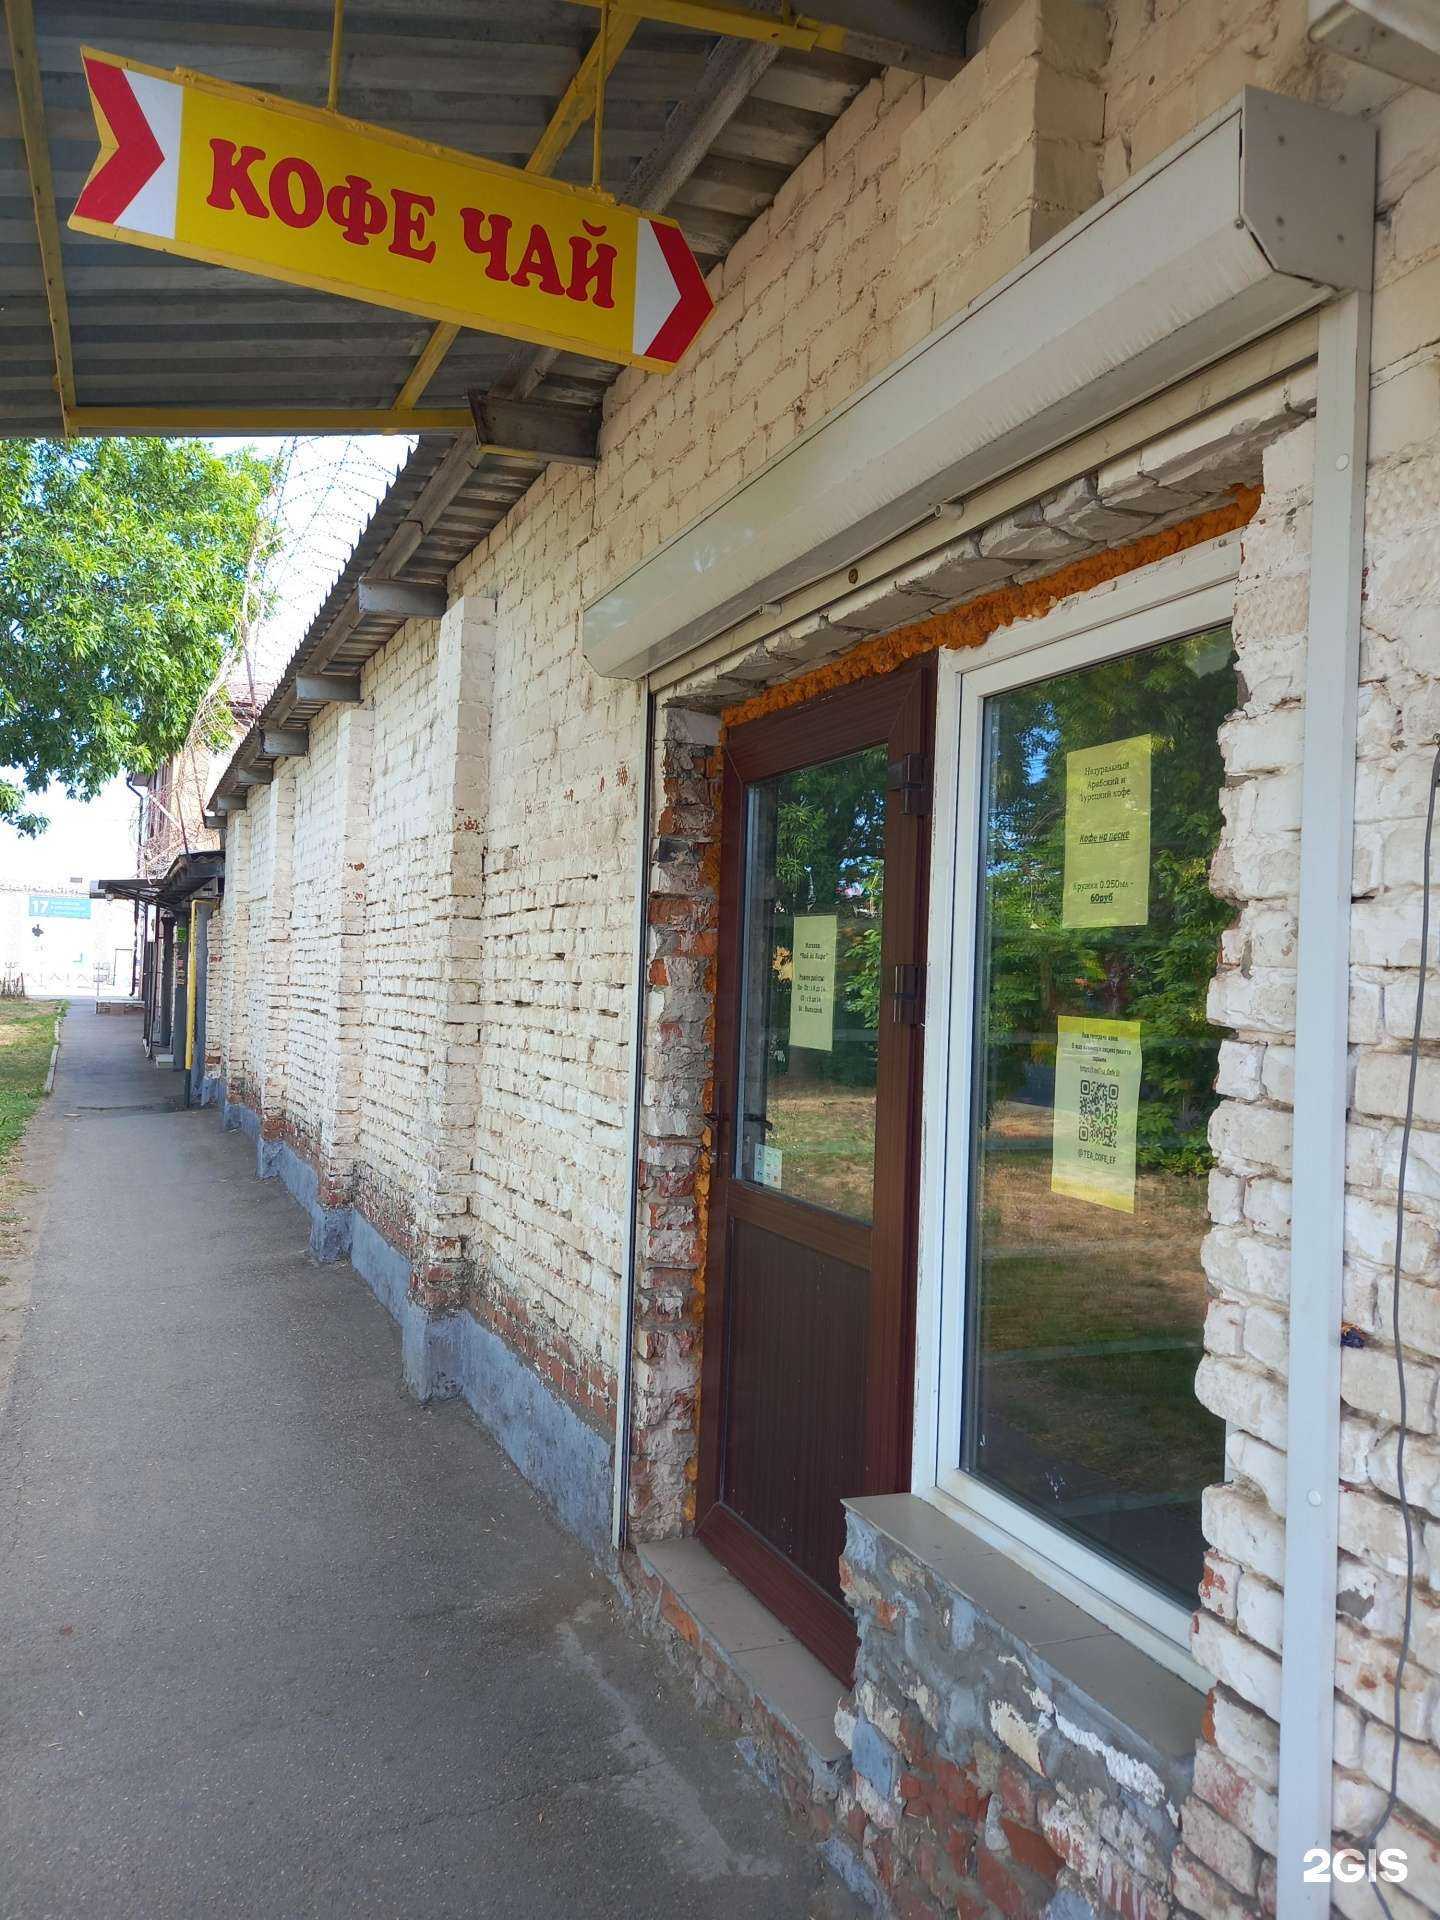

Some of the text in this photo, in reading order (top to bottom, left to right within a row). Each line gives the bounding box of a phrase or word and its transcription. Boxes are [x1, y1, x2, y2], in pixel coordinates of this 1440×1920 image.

[206, 138, 619, 310] КОФЕ ЧАЙ
[31, 900, 48, 914] 17
